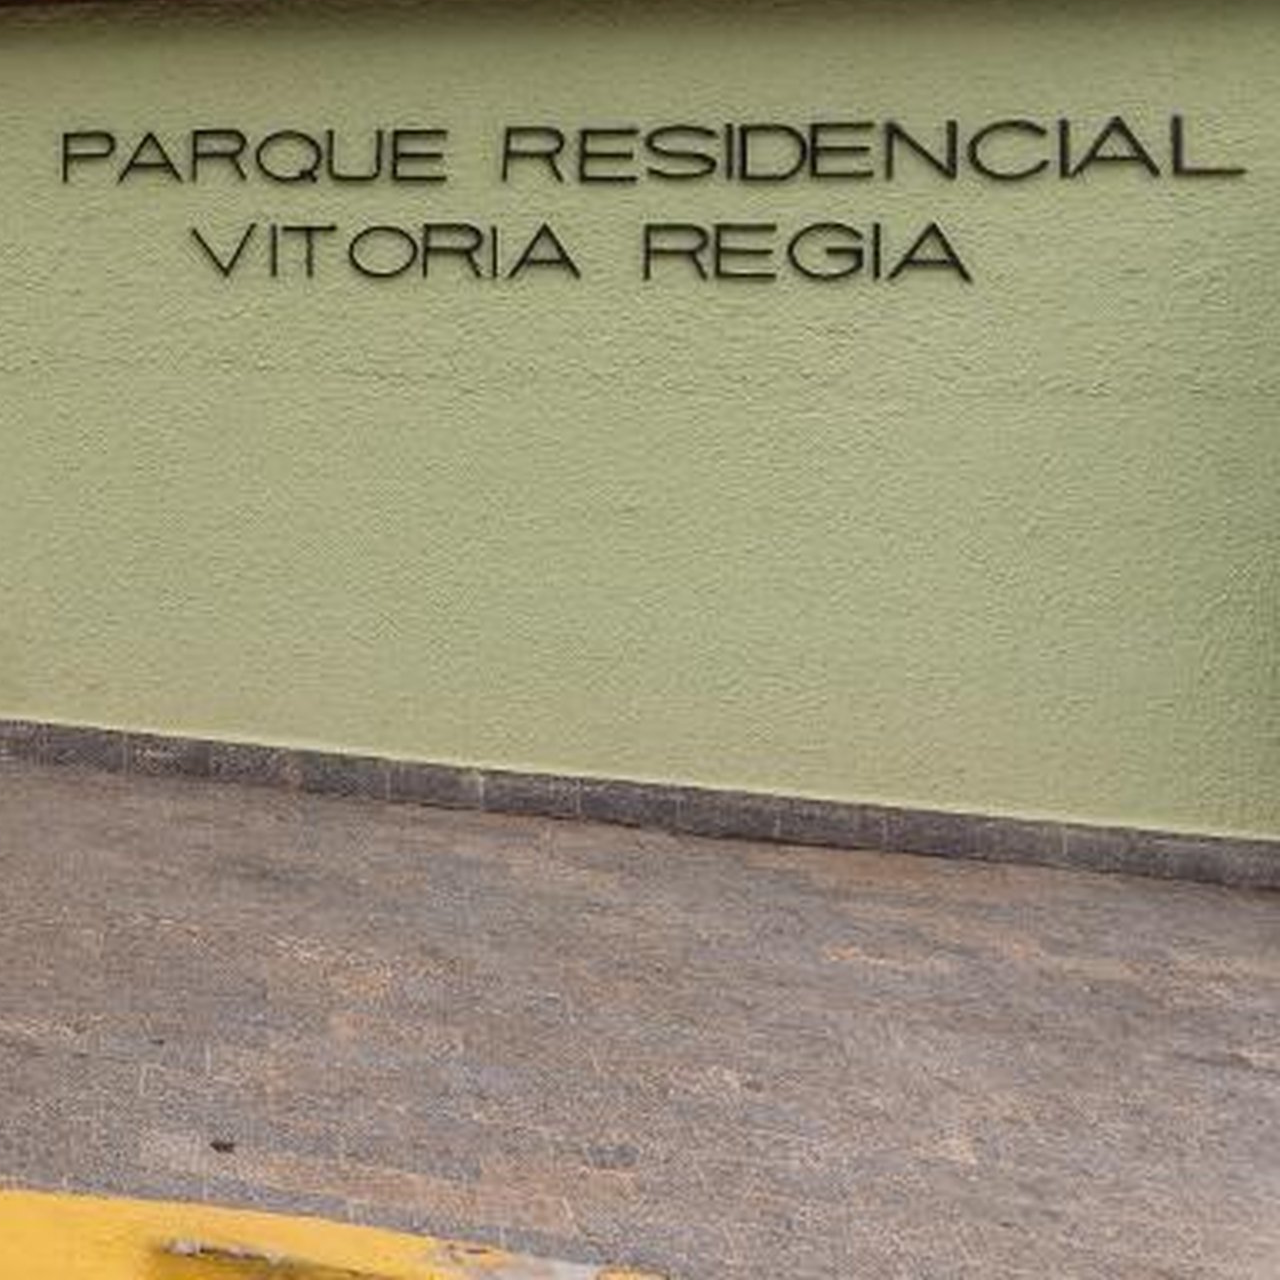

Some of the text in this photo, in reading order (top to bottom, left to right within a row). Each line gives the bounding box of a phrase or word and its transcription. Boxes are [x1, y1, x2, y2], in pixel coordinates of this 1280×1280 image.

[61, 114, 1247, 183] PARQUE RESIDENCIAL
[190, 221, 973, 283] VITORIA REGIA
